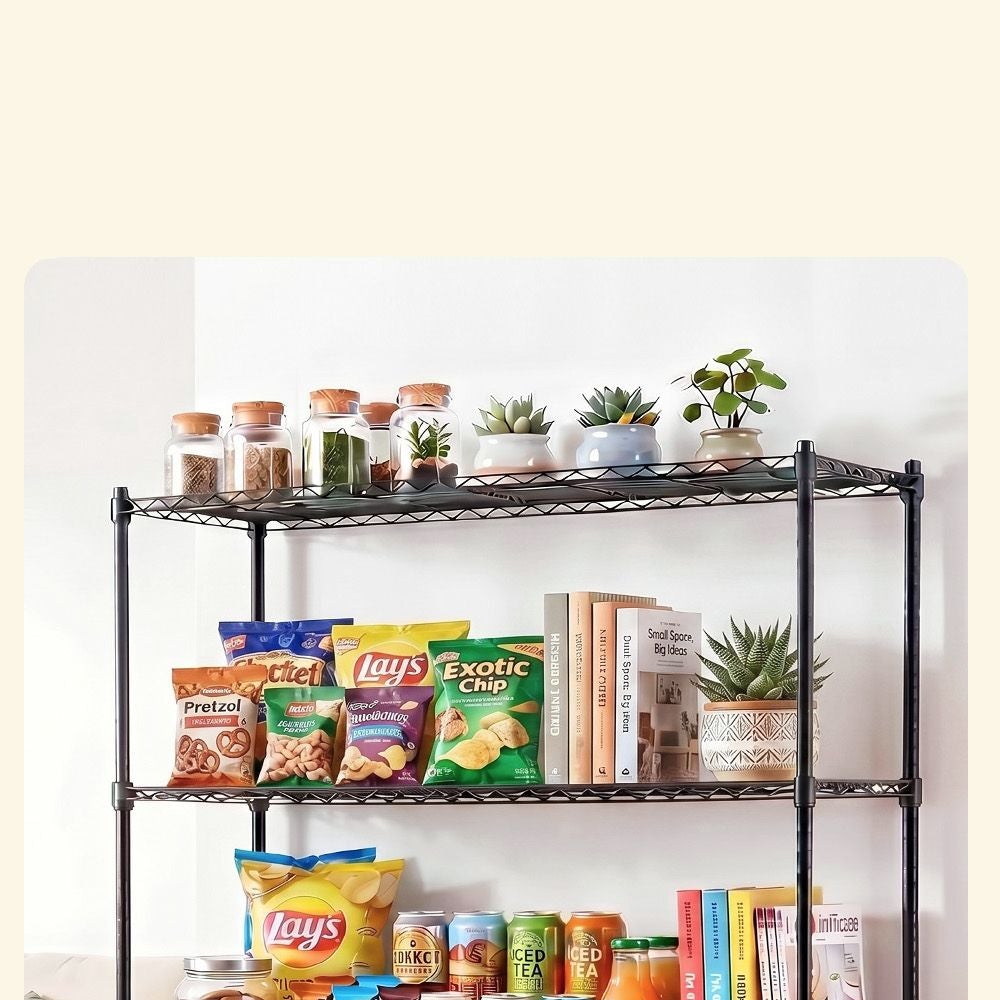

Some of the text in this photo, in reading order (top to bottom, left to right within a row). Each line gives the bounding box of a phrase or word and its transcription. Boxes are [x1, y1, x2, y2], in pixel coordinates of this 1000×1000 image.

[648, 628, 694, 643] Small Space,
[654, 643, 688, 656] Big Ideas
[357, 654, 426, 687] Lay's
[443, 657, 531, 680] Exotic
[459, 677, 508, 695] Chip
[184, 699, 241, 714] Pretzol
[268, 912, 342, 951] Lay's
[512, 949, 546, 962] ICED
[568, 945, 603, 962] ICED
[514, 963, 543, 978] TEA
[570, 962, 599, 978] TEA
